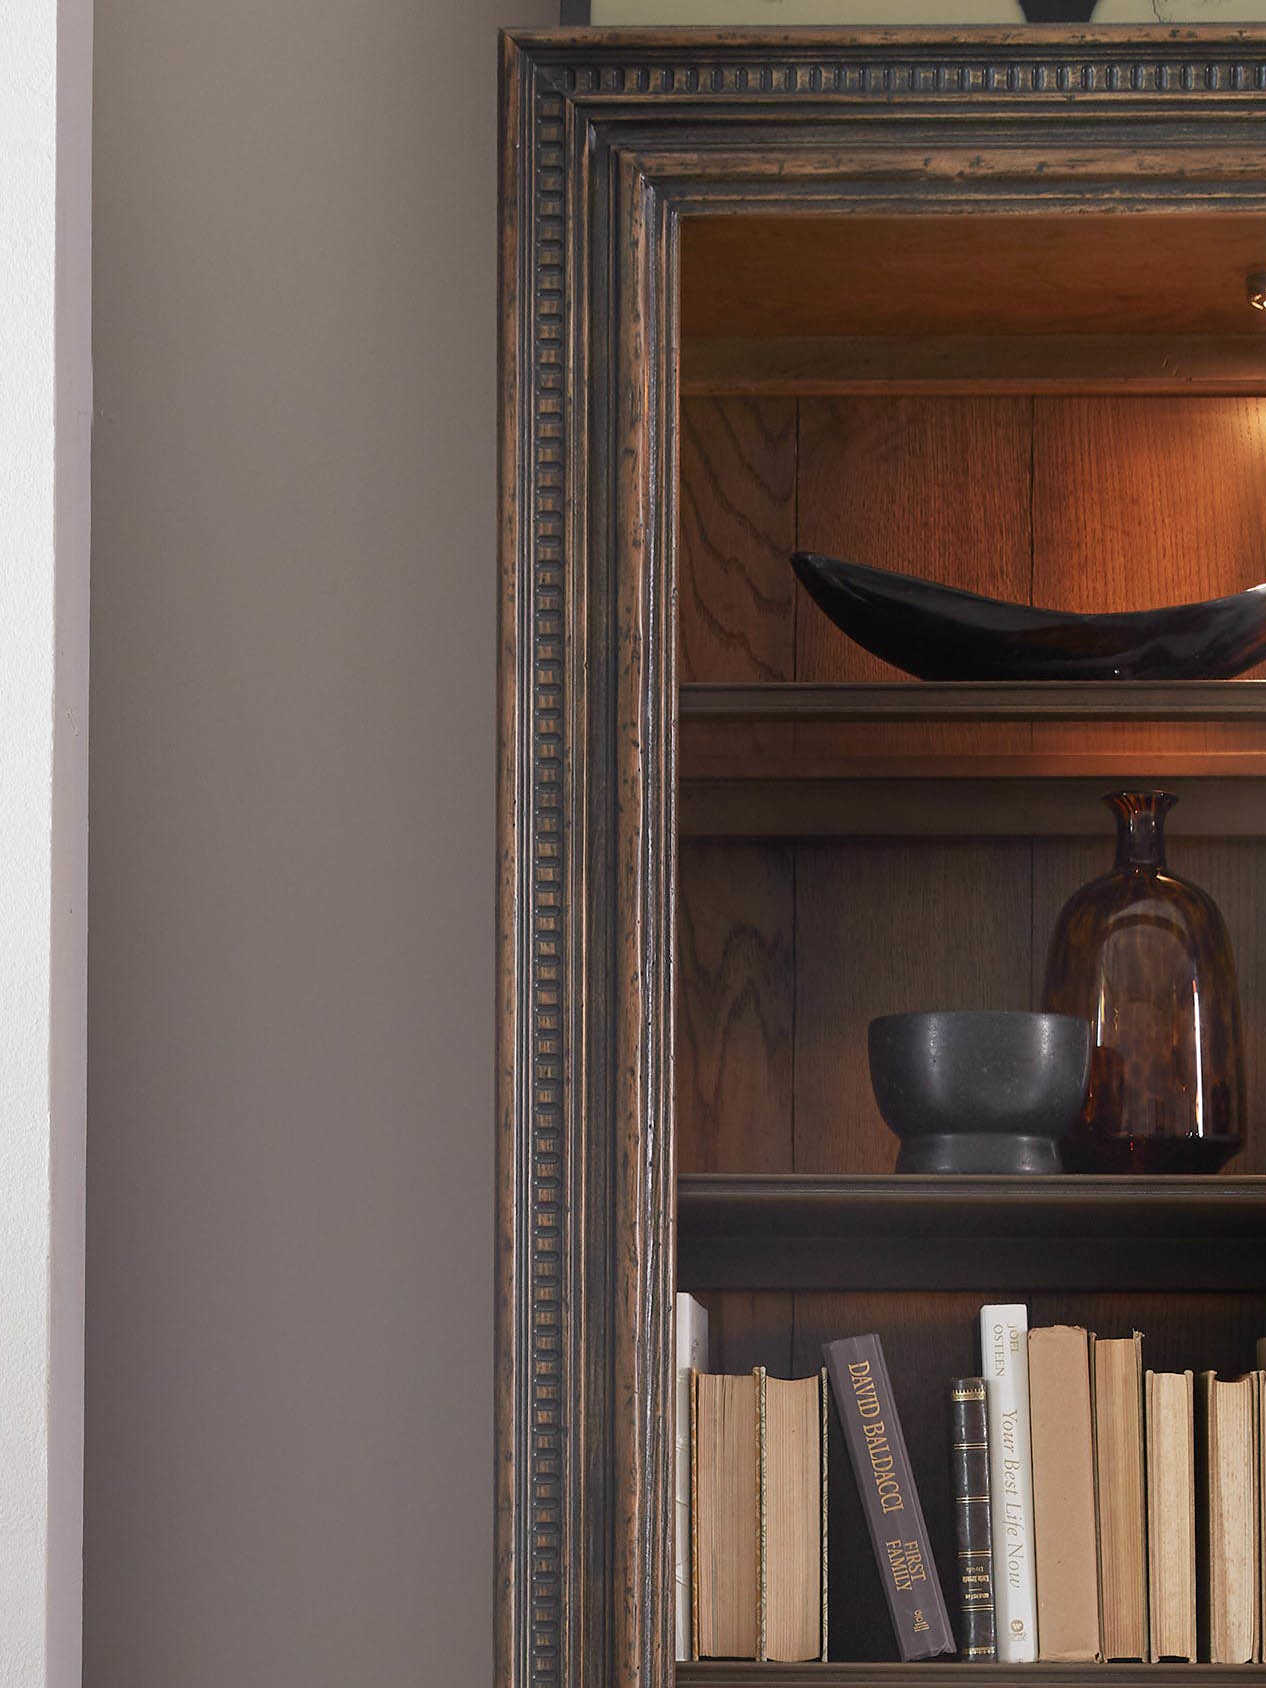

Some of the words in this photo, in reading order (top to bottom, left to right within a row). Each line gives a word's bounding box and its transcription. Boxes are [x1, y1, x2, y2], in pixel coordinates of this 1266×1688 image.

[993, 1324, 1006, 1377] OSTEEN
[1007, 1324, 1019, 1352] JOEL
[848, 1360, 880, 1418] DAVID
[1002, 1409, 1018, 1452] Your
[863, 1421, 904, 1514] BALDACCI
[1004, 1459, 1020, 1496] Best
[1002, 1503, 1022, 1537] Life
[886, 1540, 912, 1591] FAMILY
[904, 1540, 926, 1581] FIRST
[1007, 1543, 1023, 1589] Now
